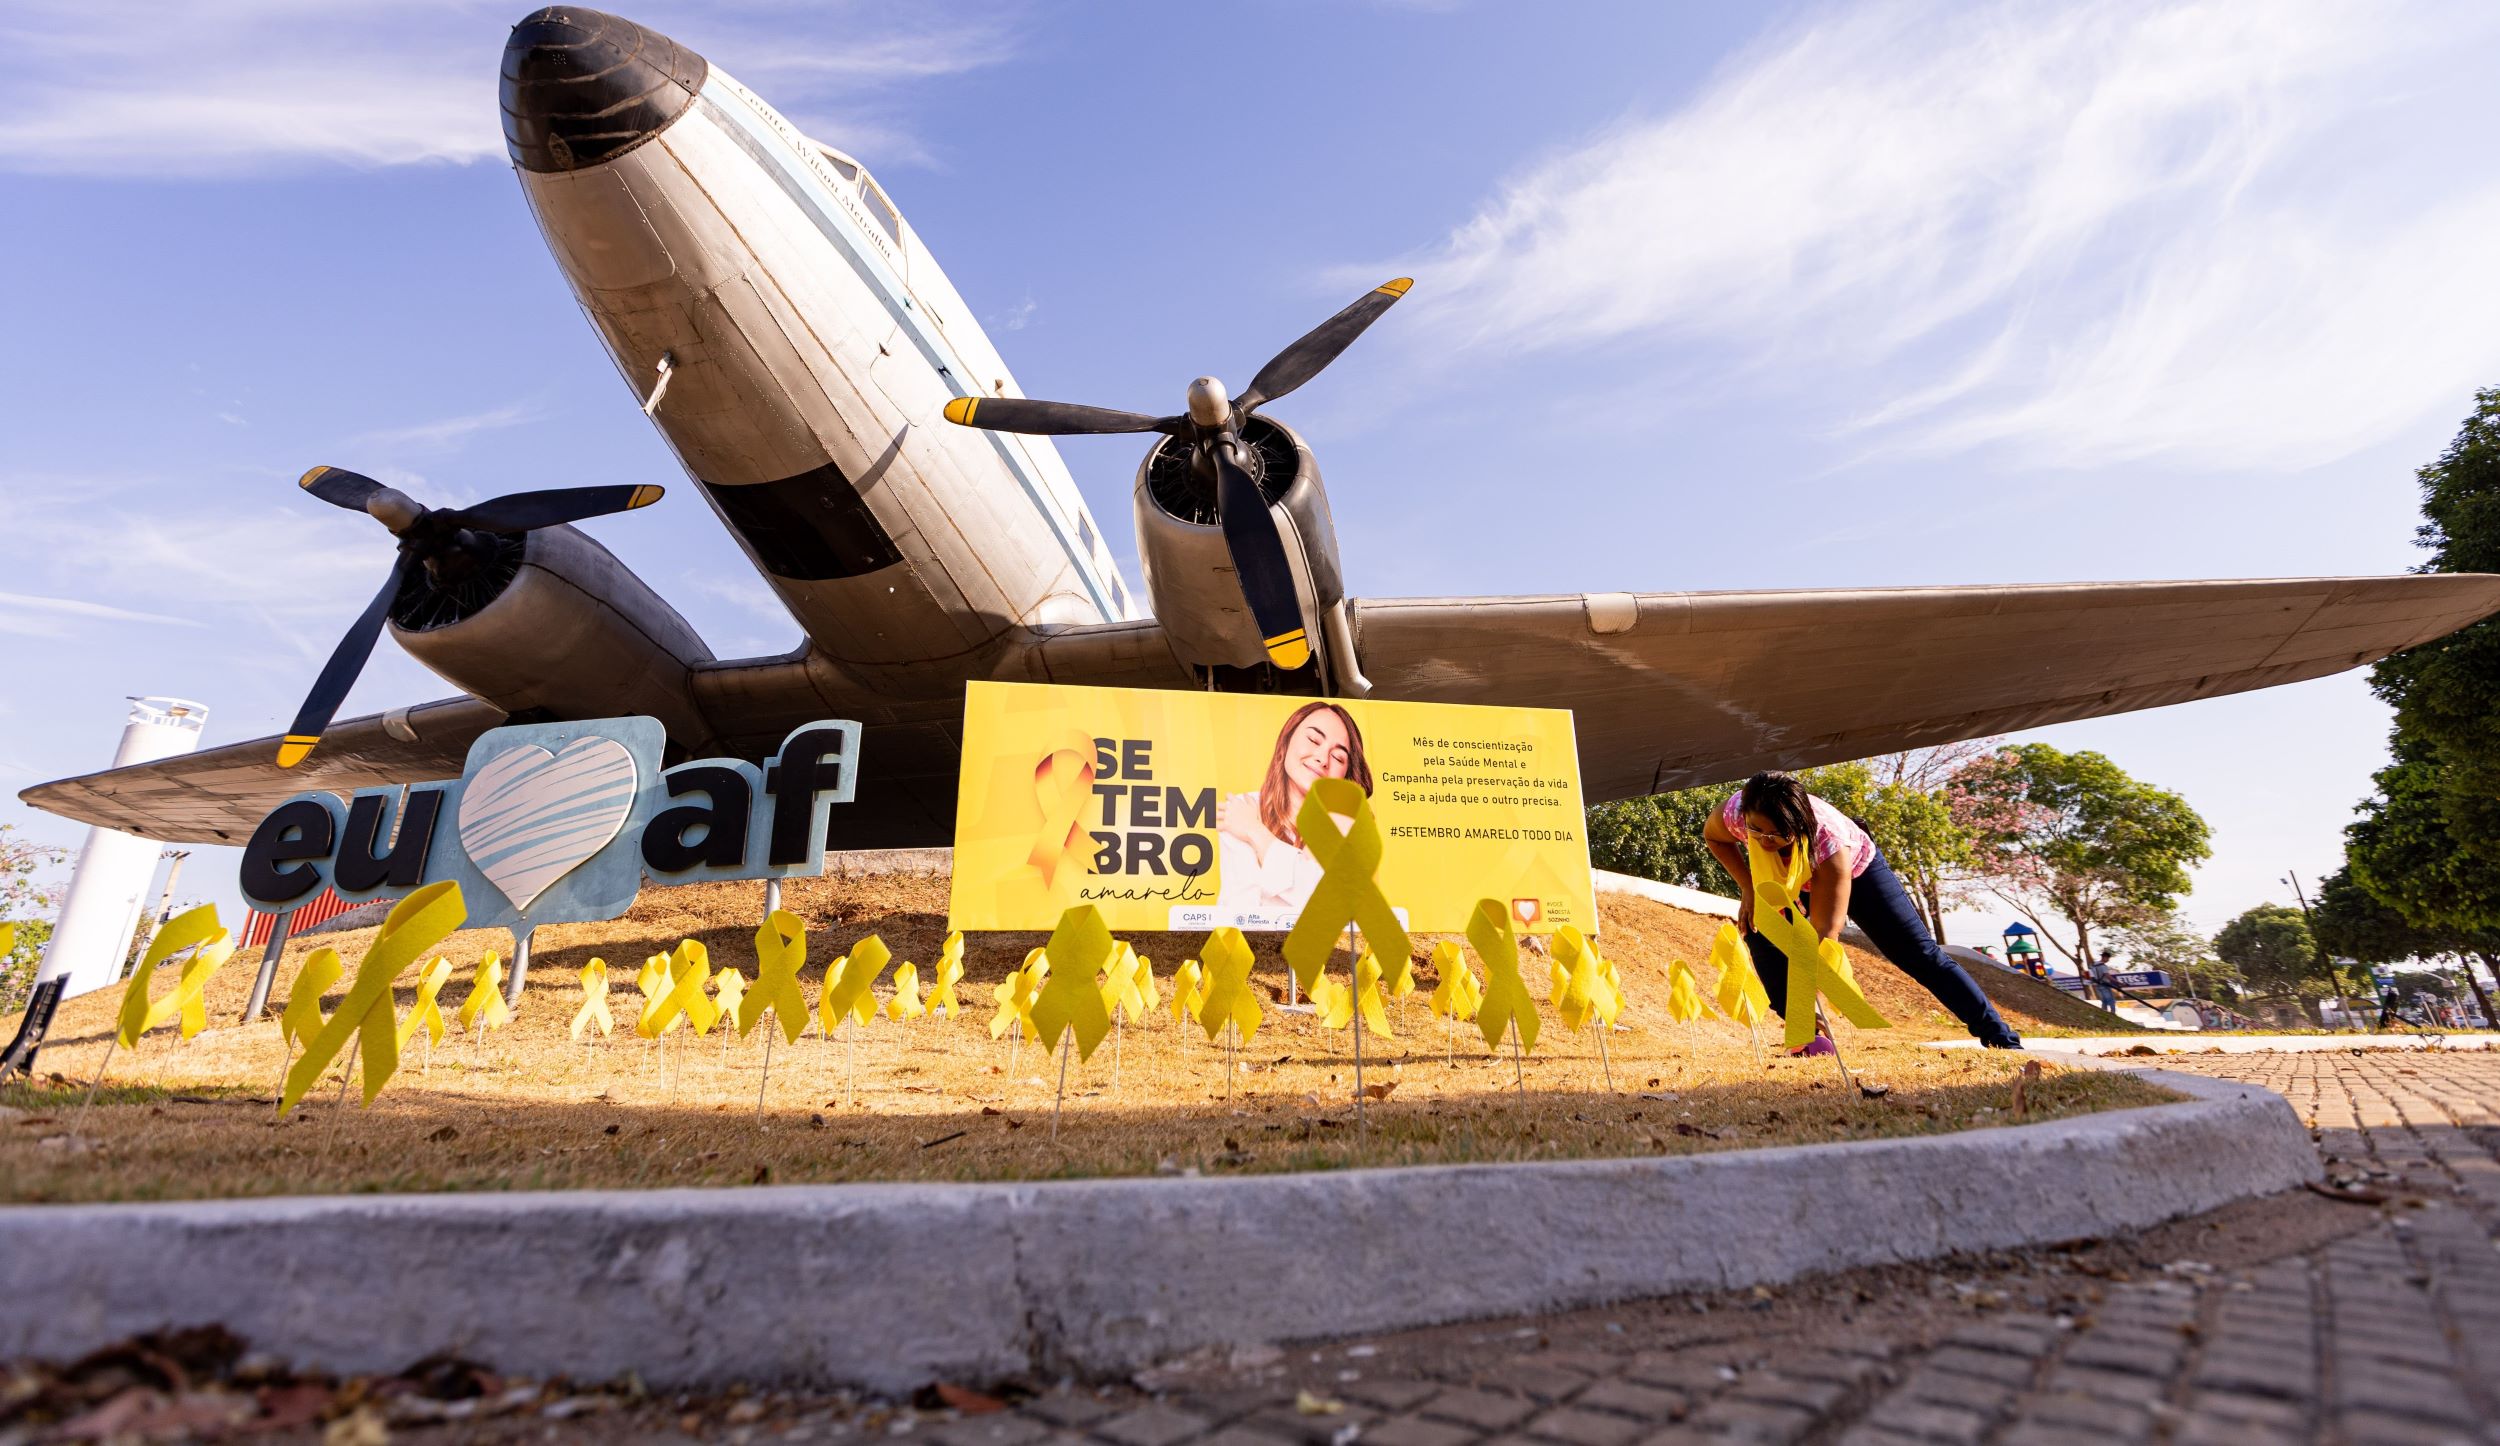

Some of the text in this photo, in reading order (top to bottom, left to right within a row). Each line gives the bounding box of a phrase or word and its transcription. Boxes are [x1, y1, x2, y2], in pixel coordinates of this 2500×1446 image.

[1413, 737, 1533, 753] Mês de conscientização
[1092, 737, 1153, 781] SE
[1423, 755, 1527, 769] pela Saúde Mental e
[1382, 772, 1568, 789] Campanha pela preservação da vida
[1091, 783, 1217, 829] TEM
[1393, 791, 1562, 808] Seja a ajuda que o outro precisa.
[239, 728, 842, 902] eu af
[1390, 826, 1573, 842] #SETEMBRO AMARELO TODO DIA
[1087, 831, 1214, 877] BRO
[1080, 868, 1215, 901] amarelo
[1183, 913, 1207, 921] CAPS
